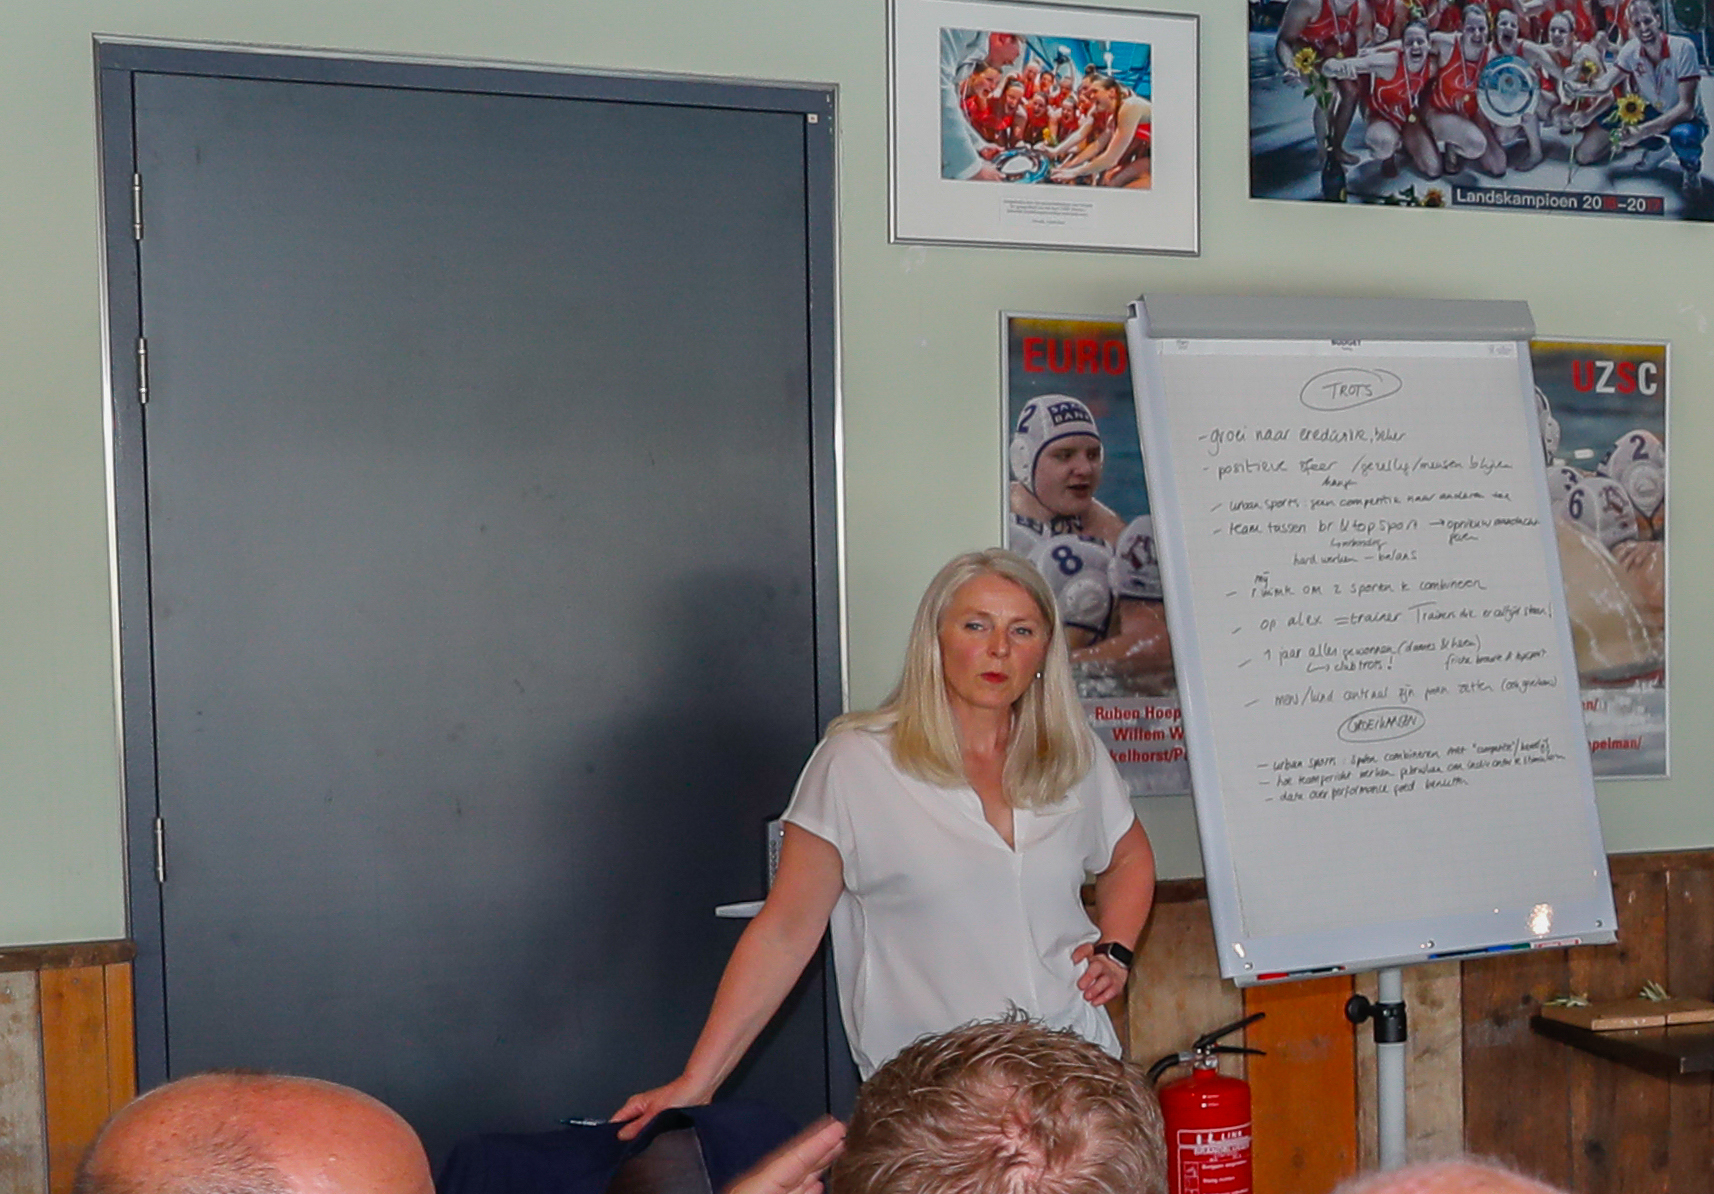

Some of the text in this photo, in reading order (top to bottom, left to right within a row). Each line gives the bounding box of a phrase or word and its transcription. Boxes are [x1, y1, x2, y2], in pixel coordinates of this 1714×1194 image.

[1456, 188, 1578, 209] Landskampioen
[1022, 336, 1128, 376] EURO
[1322, 381, 1374, 400] TROTS
[1572, 360, 1657, 395] UZSC
[1017, 404, 1037, 433] 2
[1255, 428, 1291, 441] naar
[1630, 435, 1649, 461] 2
[1569, 489, 1585, 519] 6
[1051, 545, 1084, 575] 8
[1095, 706, 1140, 720] Ruben
[1112, 727, 1165, 741] Willem
